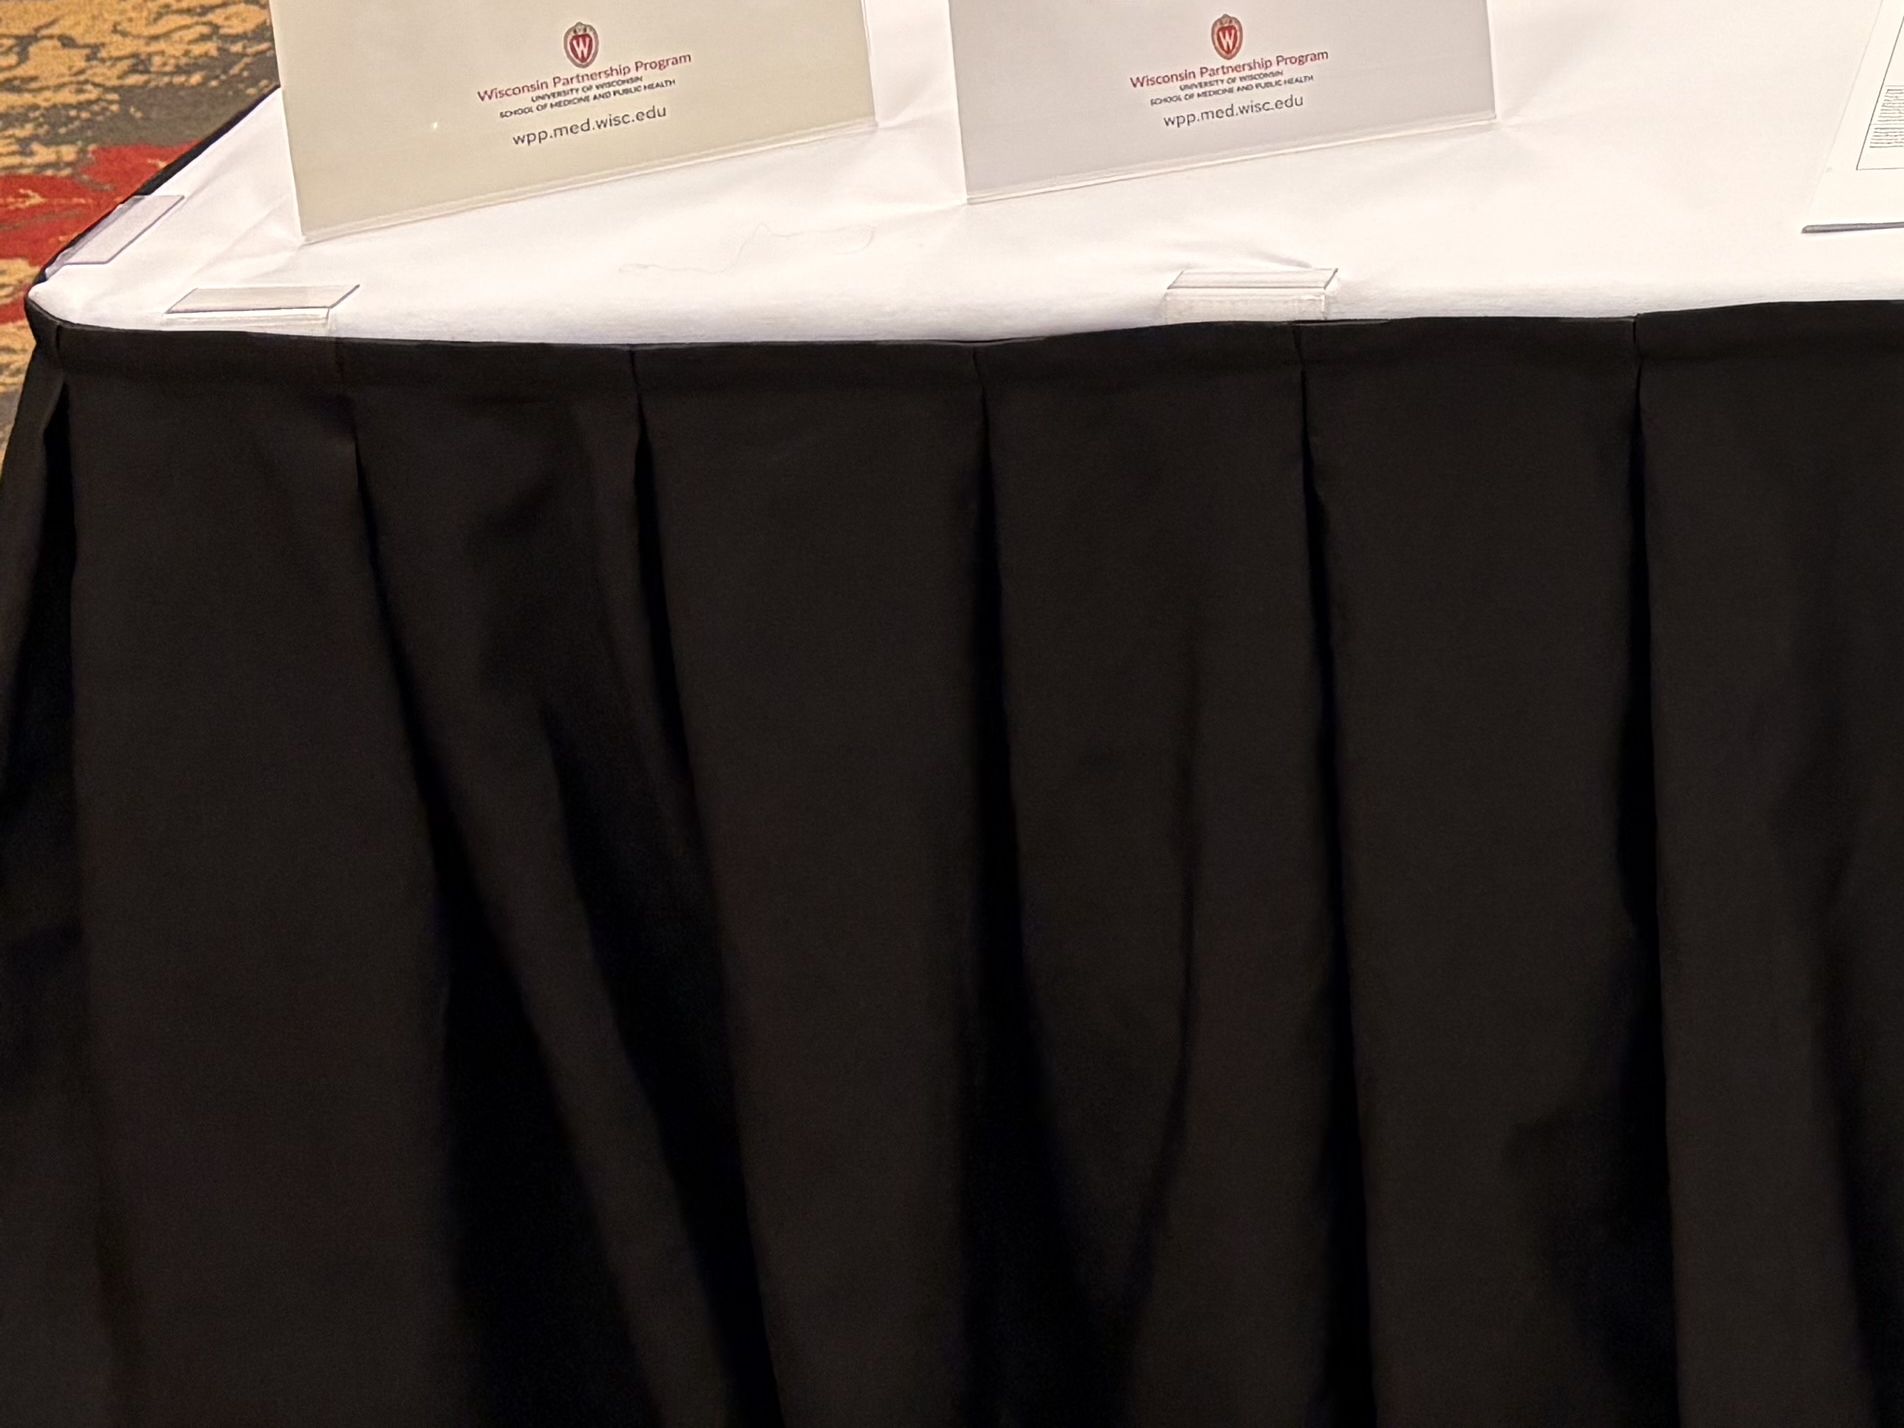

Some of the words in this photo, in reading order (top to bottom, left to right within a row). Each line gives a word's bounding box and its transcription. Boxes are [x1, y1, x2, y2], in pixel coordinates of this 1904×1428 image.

[477, 79, 548, 101] Wisconsin
[552, 64, 630, 87] Partnership
[634, 54, 691, 72] Program
[1130, 69, 1196, 87] Wisconsin
[1200, 57, 1272, 77] Partnership
[1276, 51, 1328, 66] Program
[512, 105, 666, 145] wpp.med.wisc.edu
[1163, 94, 1302, 128] wpp.med.wisc.edu
